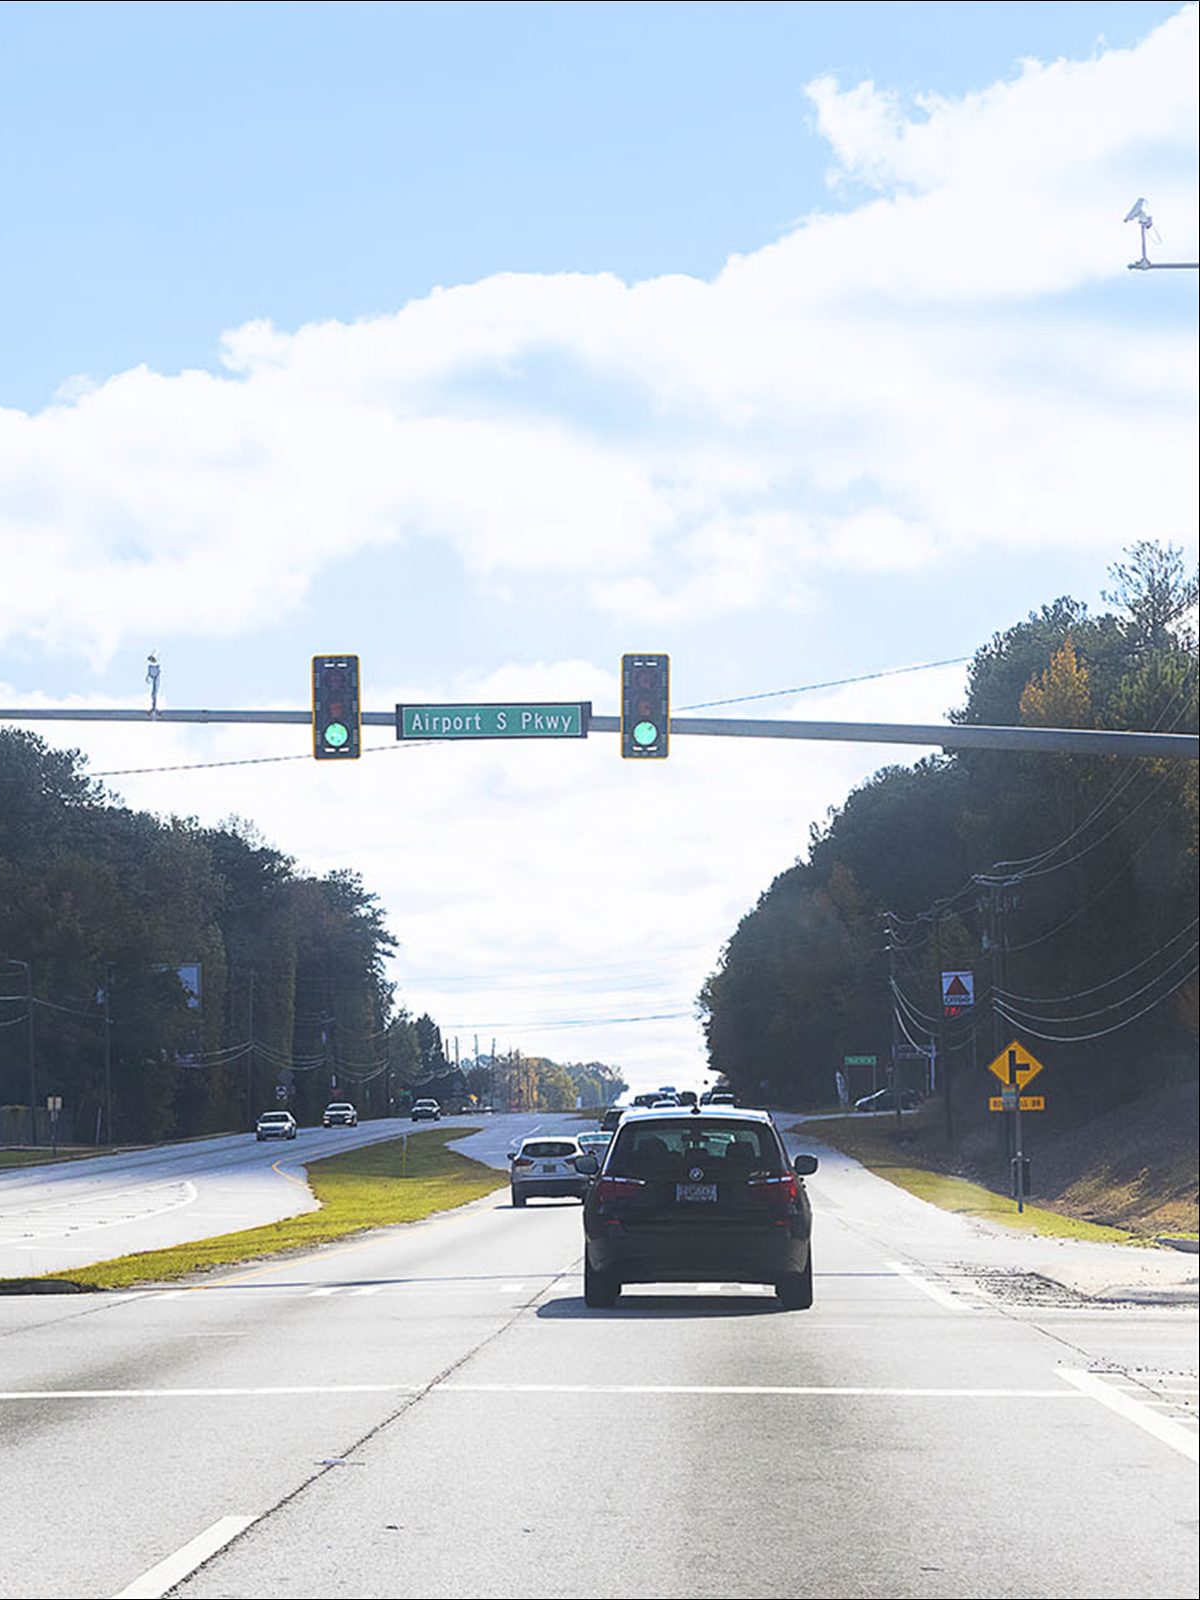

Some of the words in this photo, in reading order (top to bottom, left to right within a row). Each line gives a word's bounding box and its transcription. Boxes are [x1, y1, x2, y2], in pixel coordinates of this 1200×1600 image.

[412, 713, 481, 733] Airport
[497, 712, 507, 730] S
[522, 711, 572, 732] Pkwy
